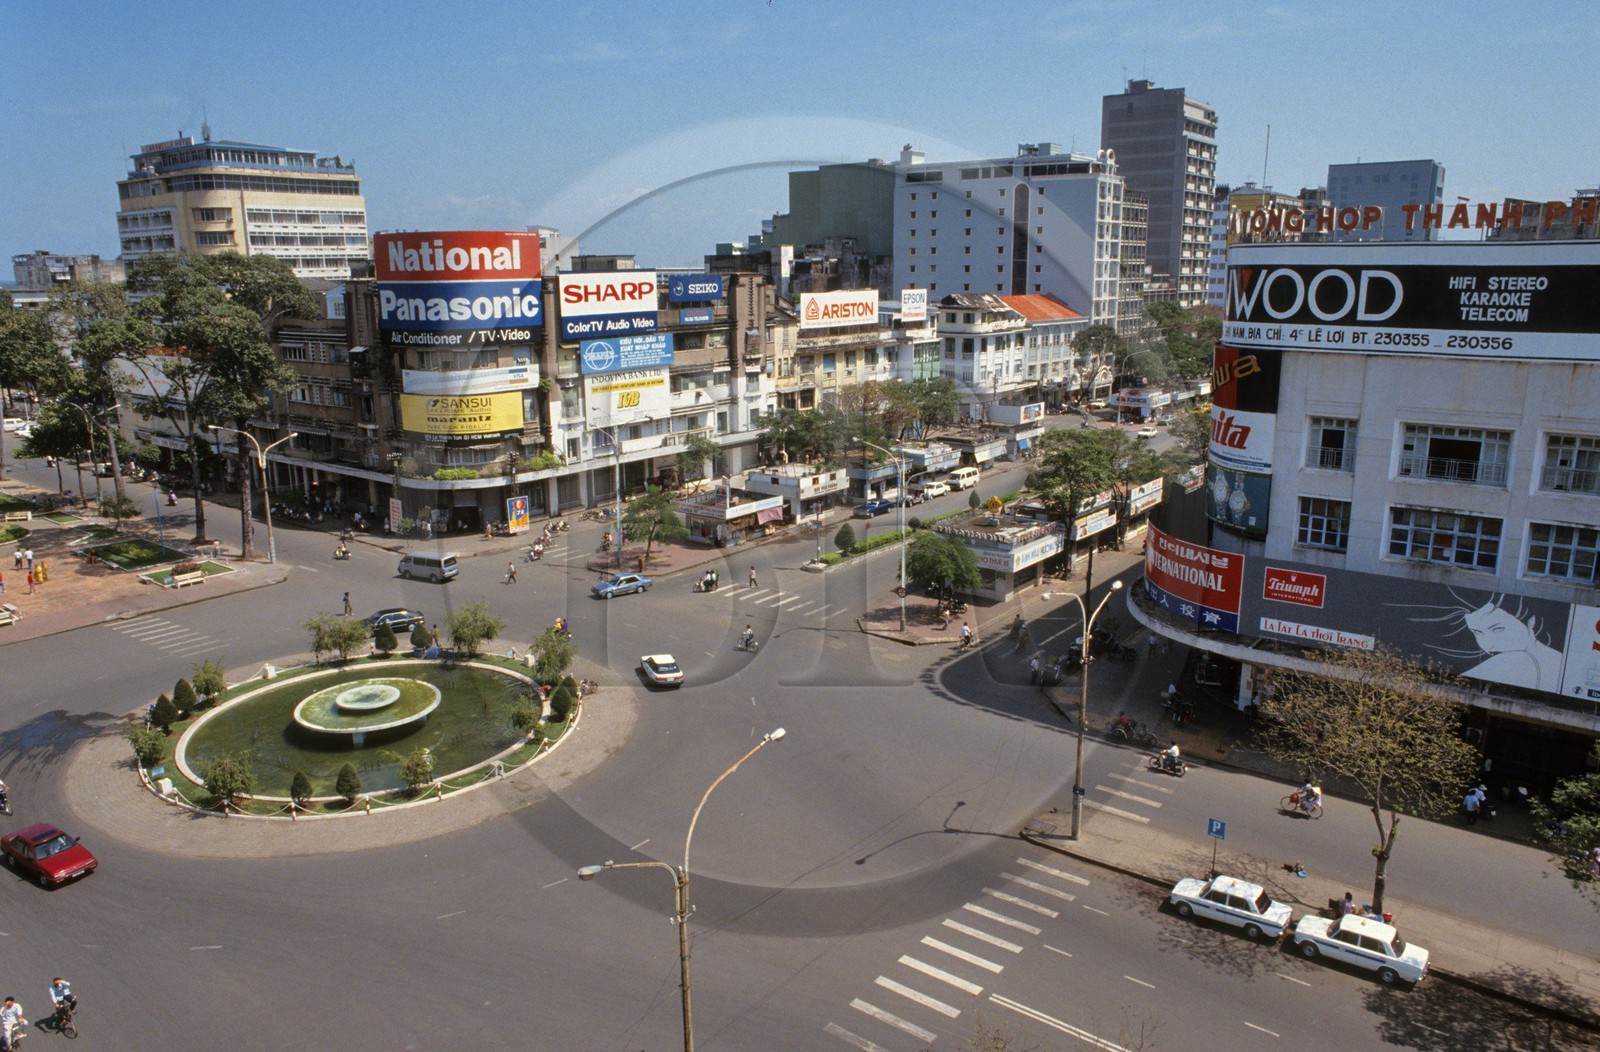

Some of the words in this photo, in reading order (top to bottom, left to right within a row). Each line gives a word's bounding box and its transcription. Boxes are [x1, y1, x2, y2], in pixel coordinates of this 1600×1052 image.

[1401, 196, 1524, 230] THÀNH
[388, 239, 521, 272] National
[688, 282, 719, 294] SEIKO
[1449, 276, 1477, 290] HIFI
[1488, 276, 1549, 291] STEREO
[563, 281, 655, 304] SHARP
[903, 293, 926, 304] EPSON
[1226, 268, 1404, 322] WOOD
[1459, 292, 1532, 307] KARAOKE
[379, 287, 539, 322] Panasonic
[821, 301, 875, 320] ARISTON
[1460, 307, 1529, 322] TELECOM
[606, 319, 630, 331] Audio
[632, 317, 655, 329] Video
[391, 331, 402, 344] Air
[402, 332, 462, 345] Conditioner
[1374, 332, 1430, 347] 230355
[1447, 335, 1513, 351] 230356
[591, 373, 627, 384] INDOVINA
[628, 369, 648, 380] BANK
[441, 397, 492, 408] SANSUI
[617, 390, 641, 409] IVB
[426, 415, 492, 423] marantz
[1268, 577, 1320, 597] Triumph
[1271, 592, 1315, 603] INTERNATIONAL
[1336, 630, 1370, 649] TRANG
[1212, 820, 1222, 833] P
